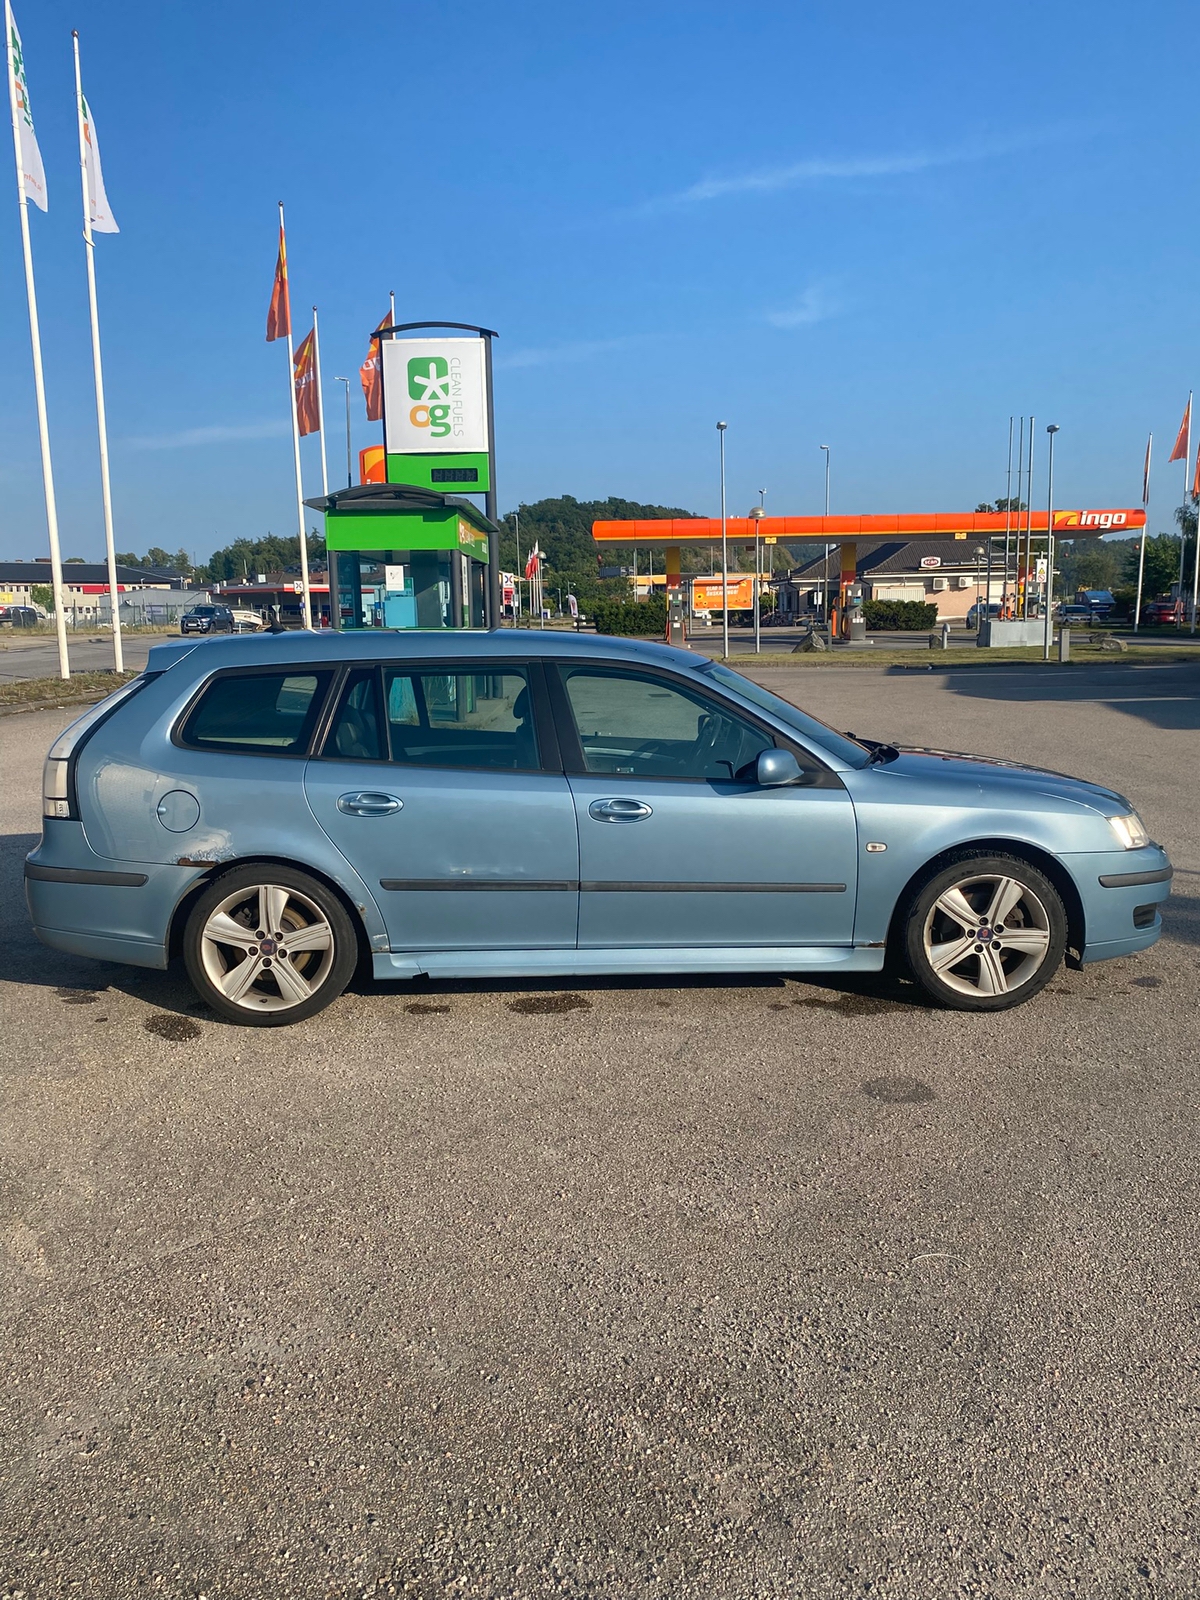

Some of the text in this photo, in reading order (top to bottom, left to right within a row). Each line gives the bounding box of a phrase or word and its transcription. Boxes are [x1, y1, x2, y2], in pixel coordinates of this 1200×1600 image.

[450, 357, 464, 437] CLEAN FUELS
[409, 404, 451, 437] og
[1080, 511, 1126, 528] ingo
